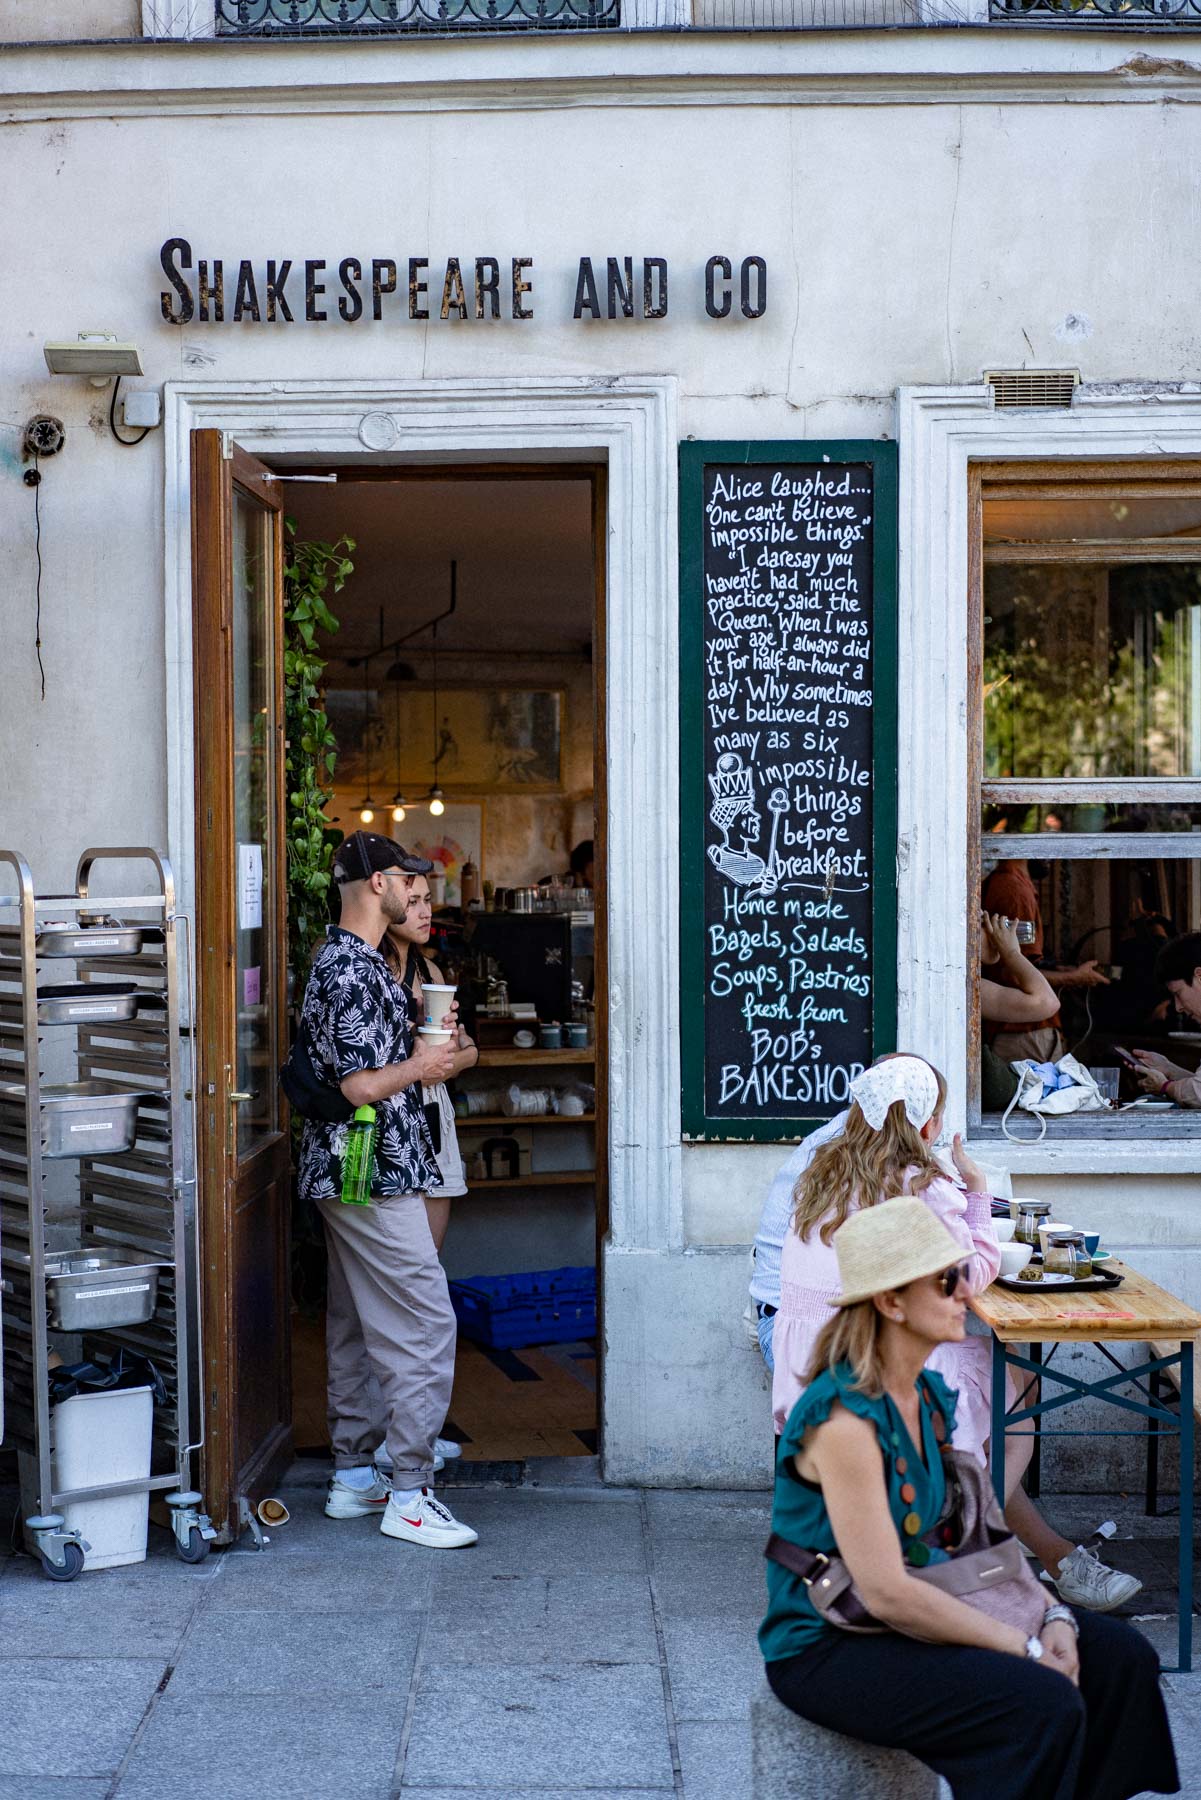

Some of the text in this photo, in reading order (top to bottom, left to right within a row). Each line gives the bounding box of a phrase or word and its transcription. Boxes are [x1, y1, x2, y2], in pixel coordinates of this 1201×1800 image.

[160, 237, 767, 326] SHAKESPEARE AND CO
[712, 473, 764, 503] Alice
[745, 500, 785, 521] can't
[792, 499, 857, 521] believe
[711, 521, 798, 552] impossible
[757, 545, 820, 576] daresay
[821, 552, 853, 576] you
[706, 568, 858, 594] haven't had much
[784, 591, 822, 610] said
[829, 591, 861, 612] the
[718, 611, 868, 636] Queen. When I was
[706, 631, 870, 660] your age I always did
[706, 649, 863, 682] it for half-an-hour a
[707, 674, 872, 707] day. Why sometimes
[708, 699, 849, 728] I've believed as
[713, 729, 840, 760] many as six
[757, 756, 870, 789] impossible
[793, 784, 862, 822] things
[784, 818, 850, 851] before
[775, 847, 868, 880] breakfast.
[724, 887, 849, 924] Home made
[709, 920, 868, 961] Bagels, Salads,
[711, 959, 871, 997] Soups, Pastries
[741, 992, 848, 1031] fresh from
